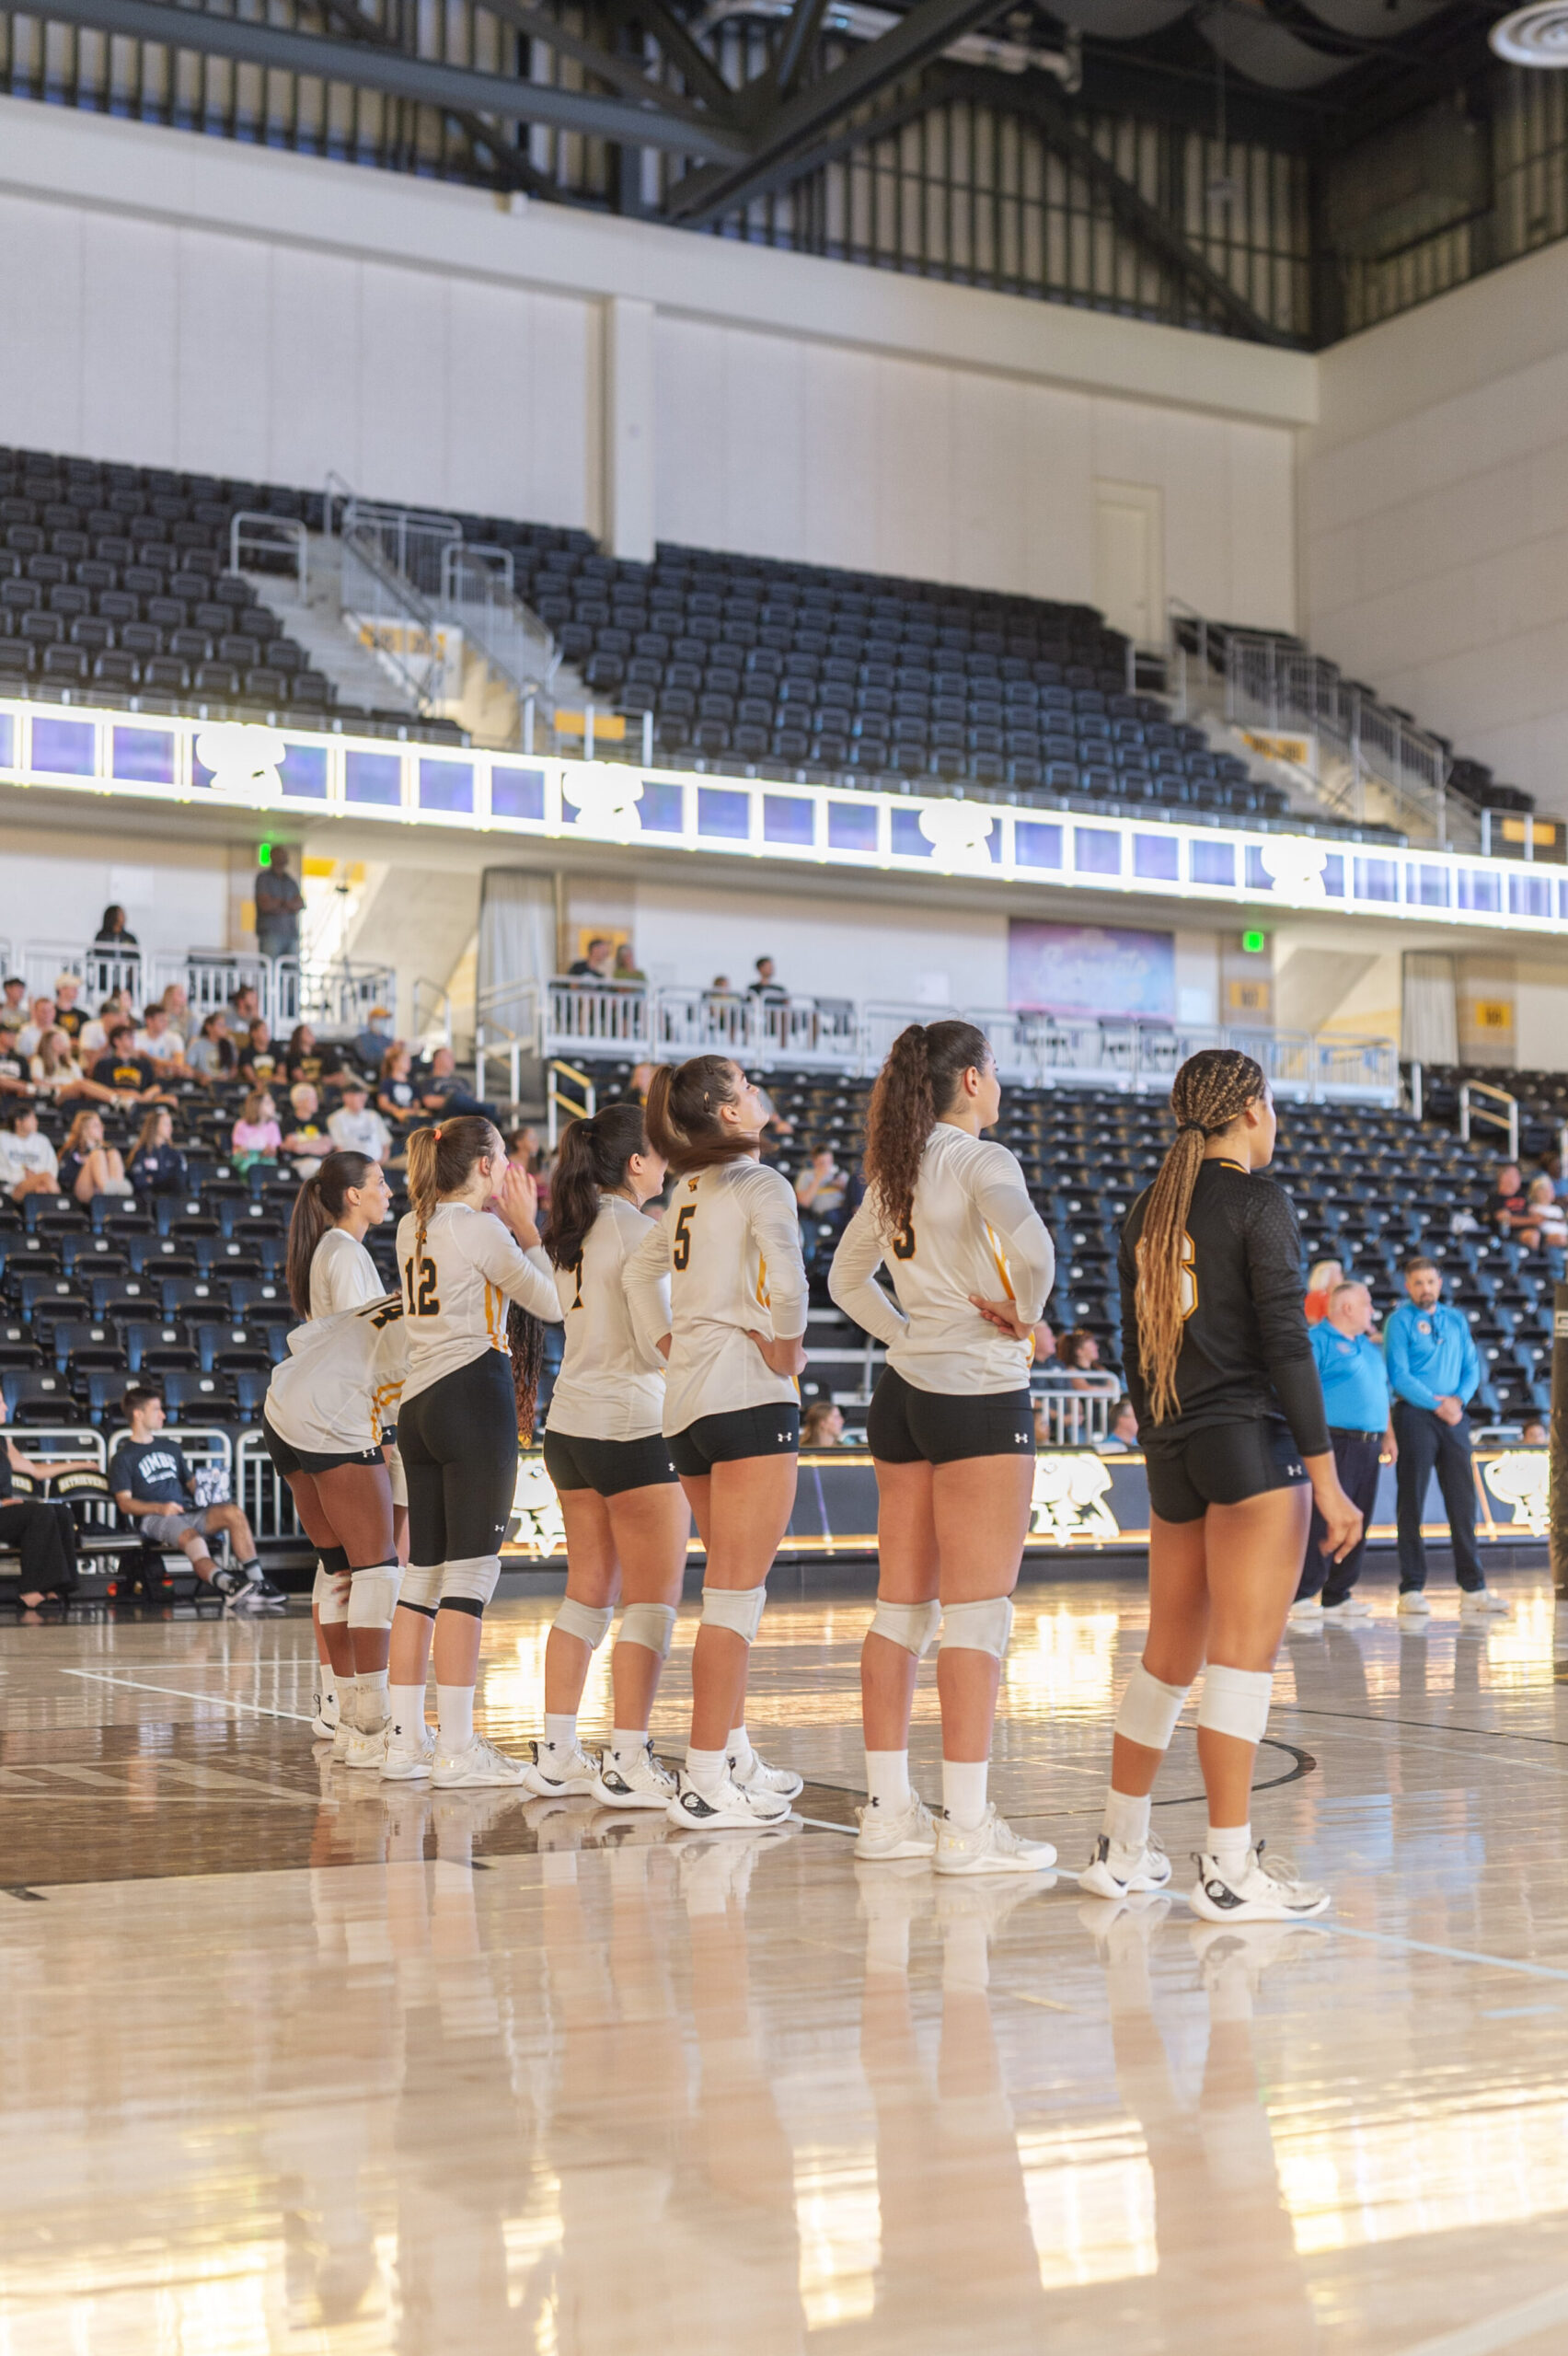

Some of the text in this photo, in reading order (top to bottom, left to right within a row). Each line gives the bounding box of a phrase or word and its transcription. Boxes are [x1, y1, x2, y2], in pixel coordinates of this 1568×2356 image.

[673, 1203, 698, 1273] 5
[404, 1256, 441, 1316] 12
[138, 1451, 178, 1479] UMBC
